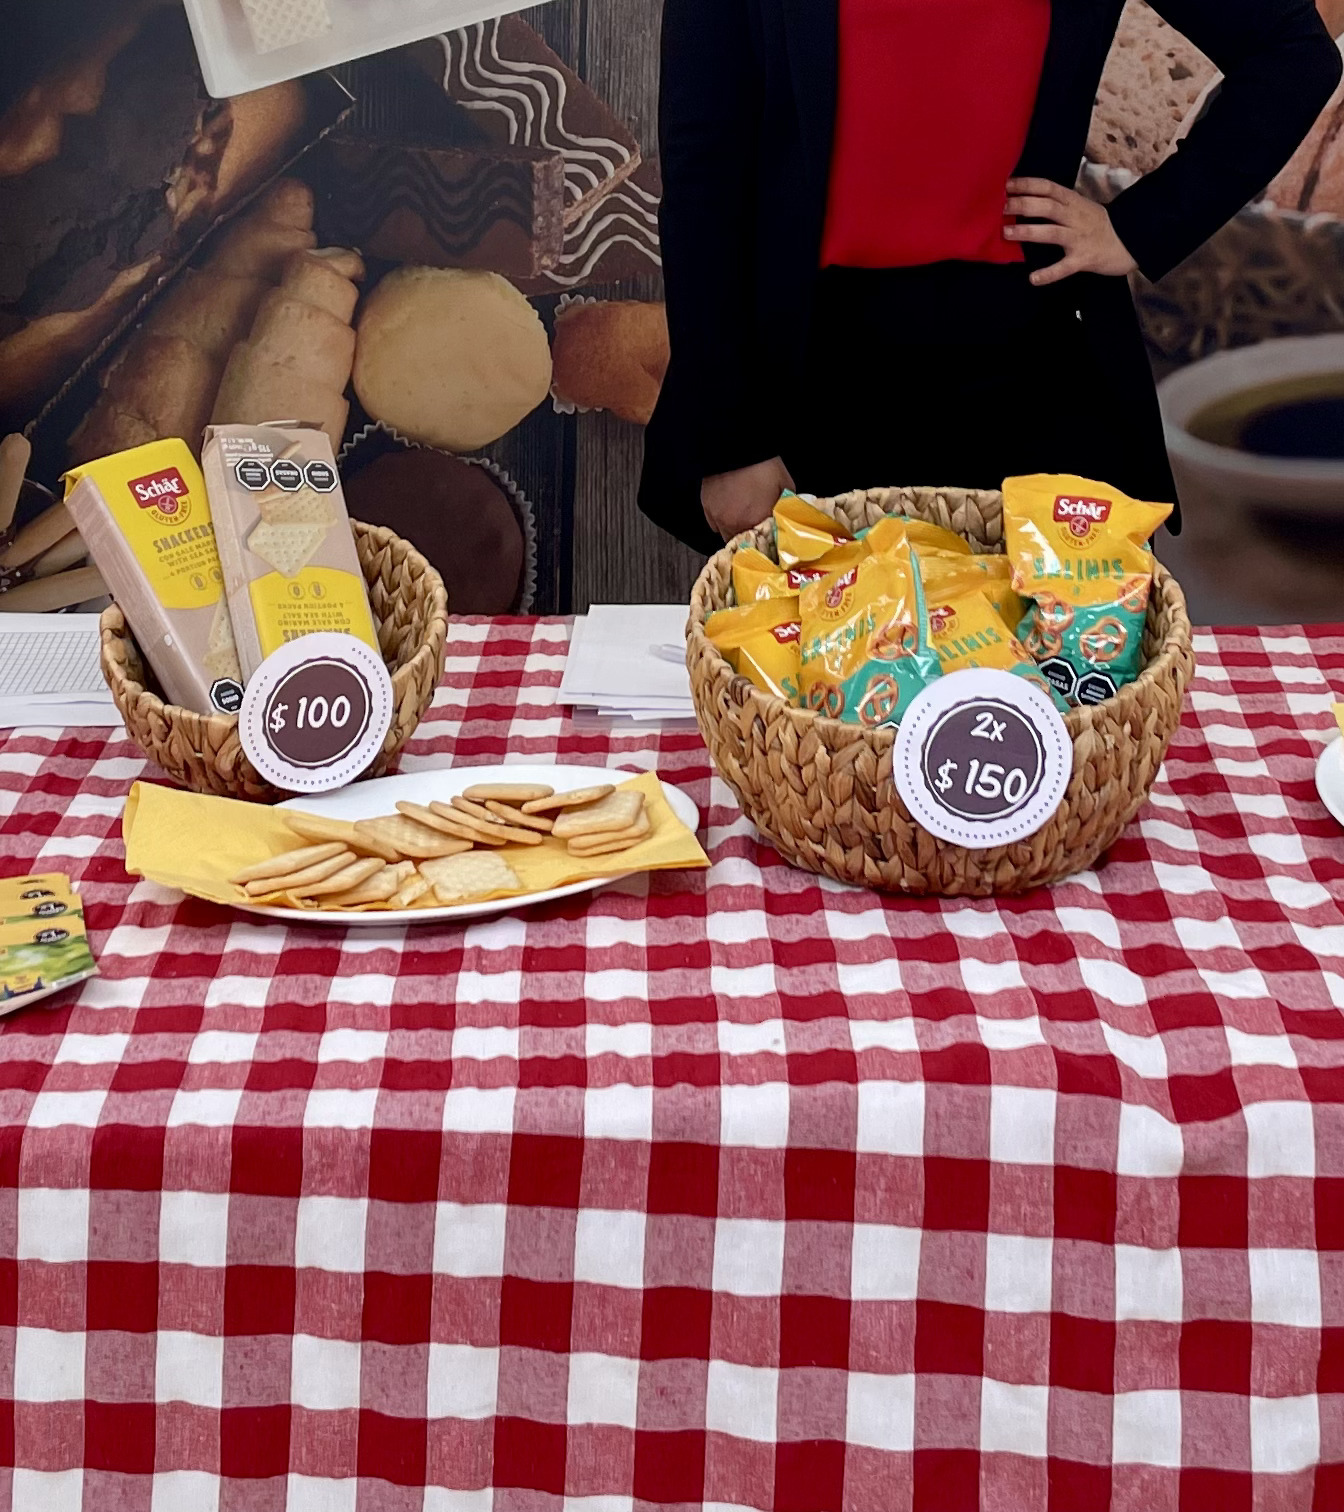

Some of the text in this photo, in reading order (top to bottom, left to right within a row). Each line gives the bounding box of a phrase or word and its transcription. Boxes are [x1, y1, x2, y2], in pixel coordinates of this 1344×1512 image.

[135, 476, 182, 501] Schär
[1057, 497, 1107, 520] Schär
[167, 557, 188, 567] WITH
[189, 551, 205, 561] SEA
[175, 546, 194, 557] SALE
[269, 695, 351, 734] $ 100
[970, 711, 1005, 743] 2x
[934, 757, 1028, 805] $ 150
